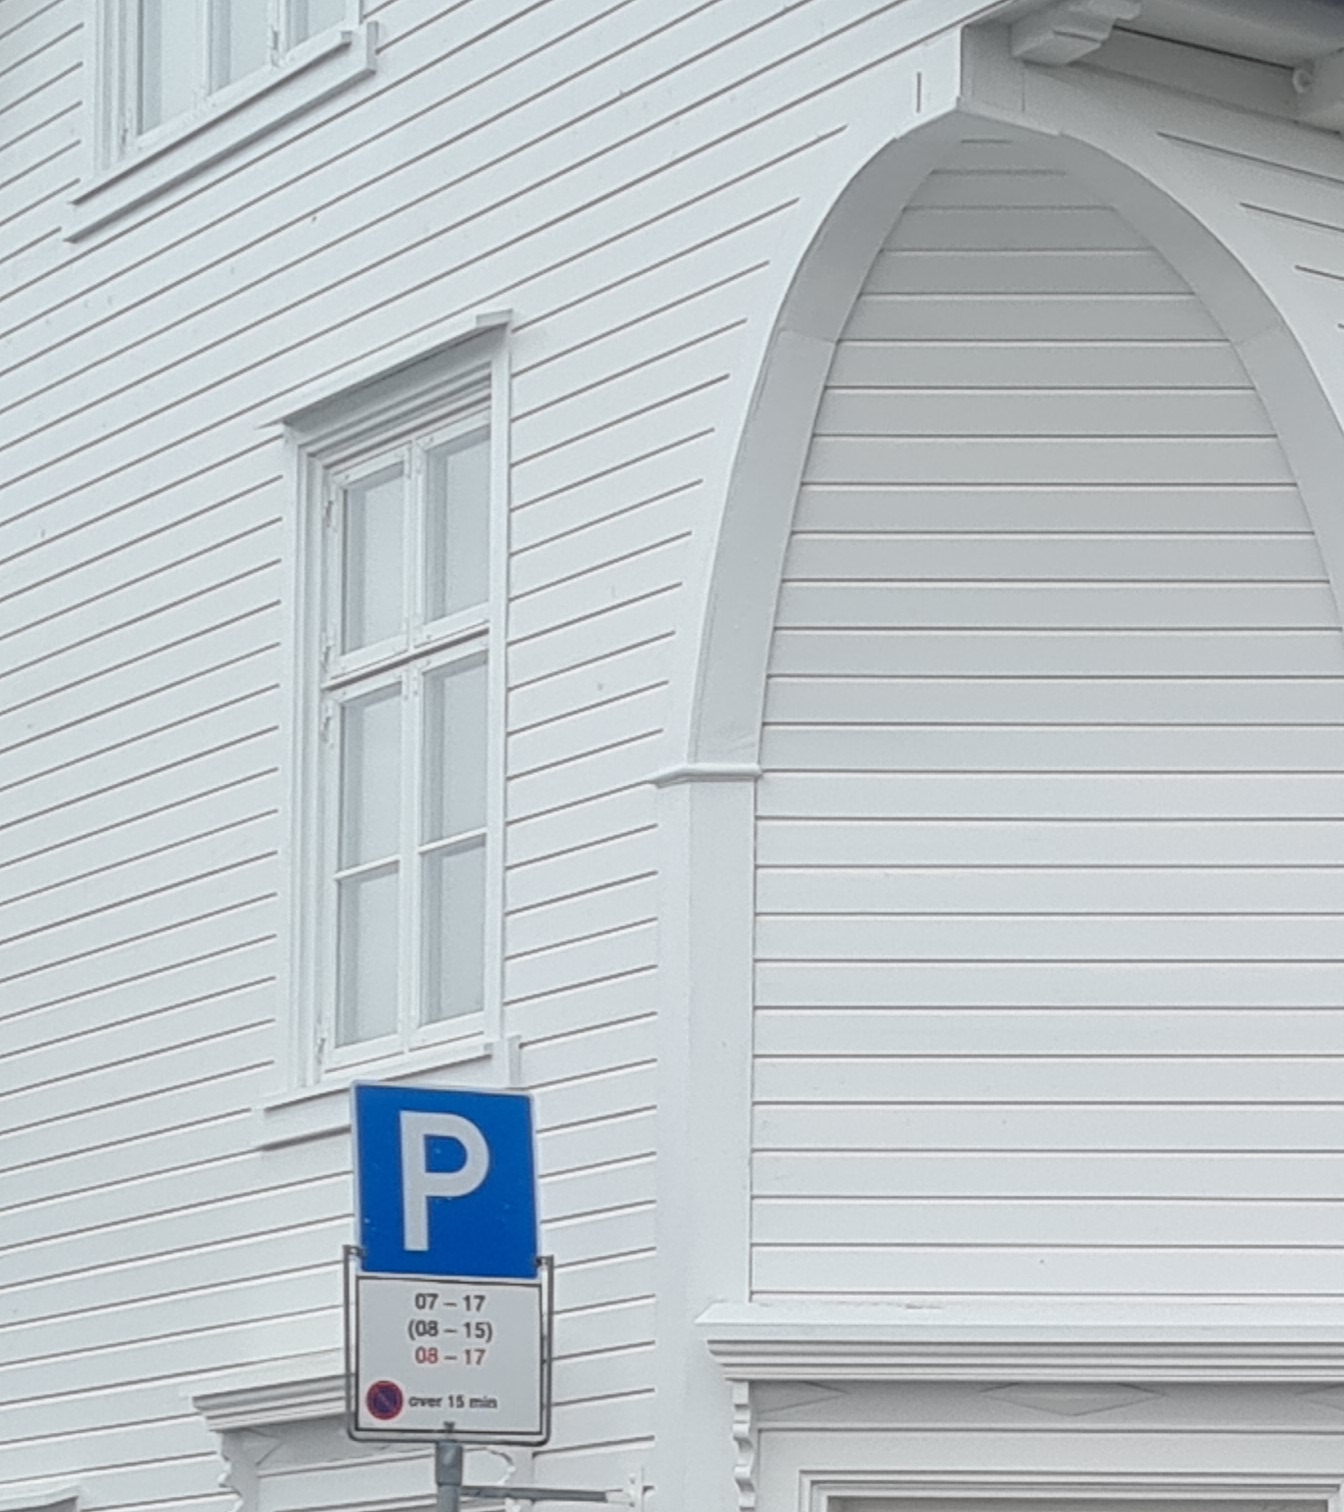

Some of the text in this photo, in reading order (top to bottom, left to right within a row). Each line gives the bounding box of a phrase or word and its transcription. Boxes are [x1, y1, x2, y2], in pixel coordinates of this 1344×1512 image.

[400, 1110, 490, 1252] P
[414, 1292, 439, 1310] 07
[463, 1294, 486, 1312] 17
[407, 1319, 439, 1341] (08
[463, 1321, 493, 1343] 15)
[414, 1346, 439, 1365] 08
[464, 1348, 486, 1366] 17
[407, 1394, 498, 1409] over 15 min
